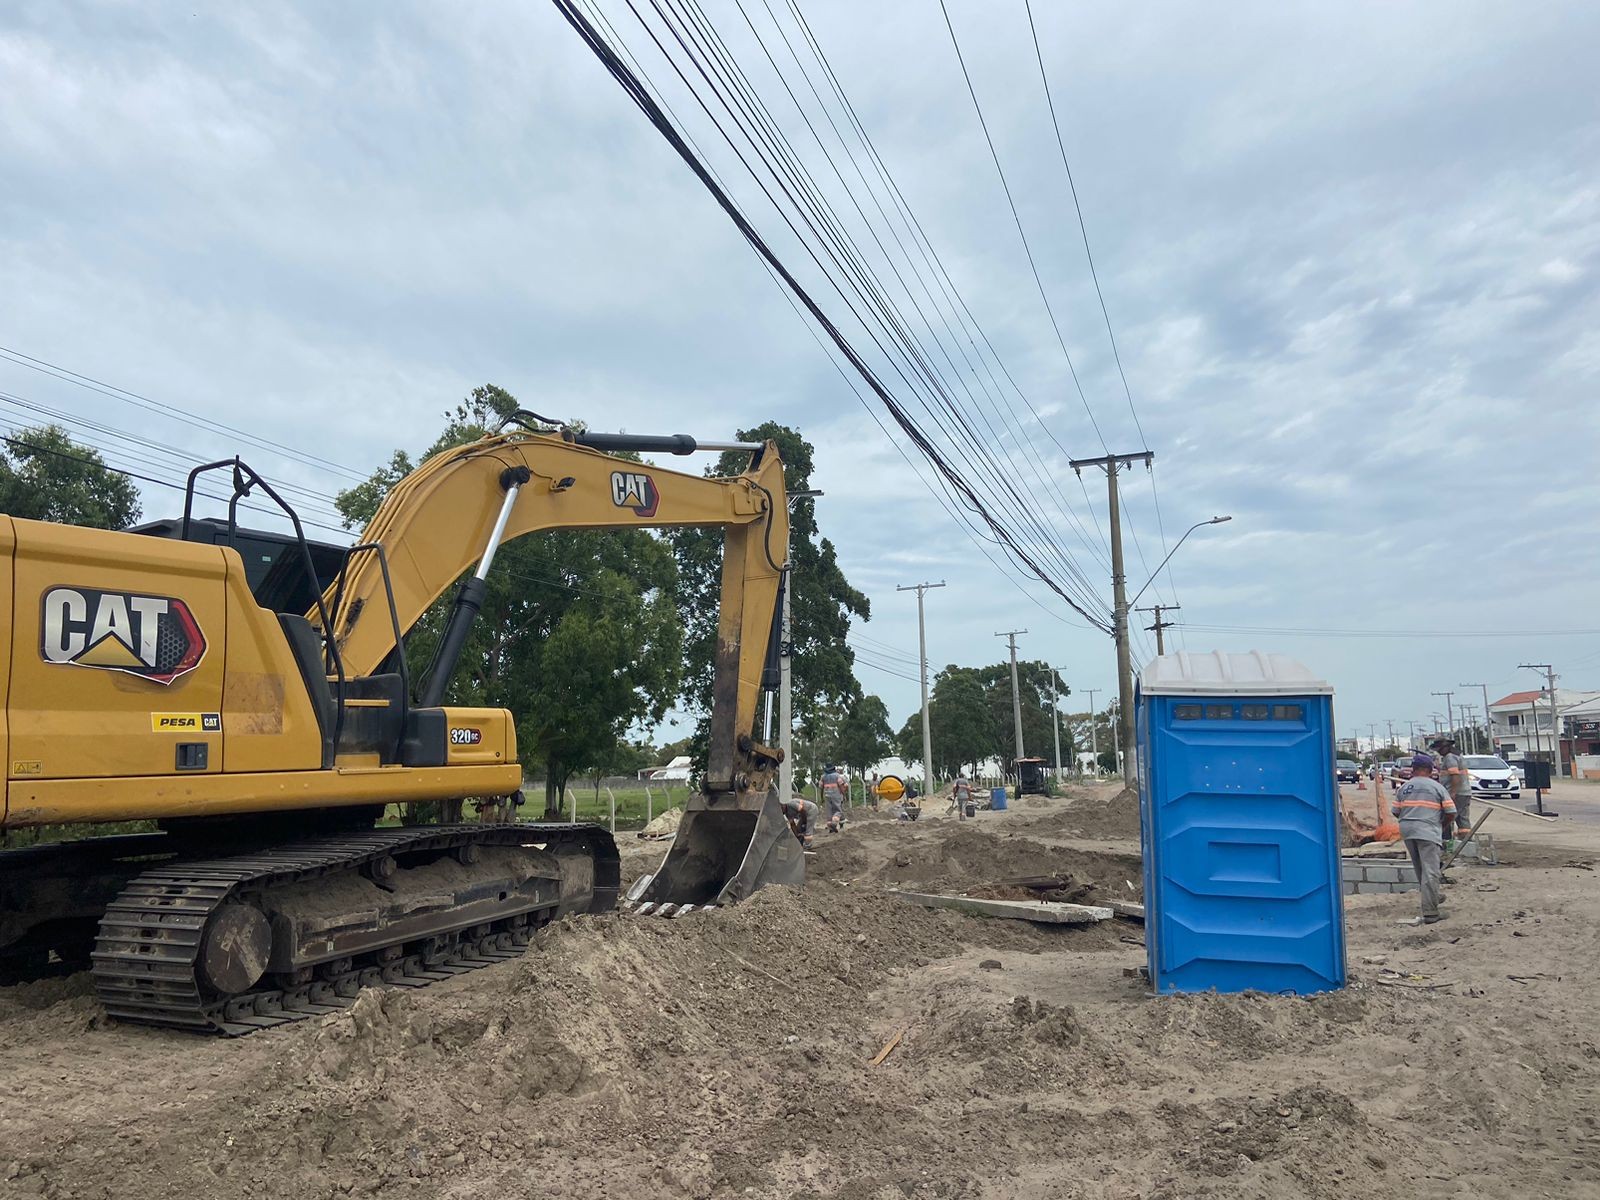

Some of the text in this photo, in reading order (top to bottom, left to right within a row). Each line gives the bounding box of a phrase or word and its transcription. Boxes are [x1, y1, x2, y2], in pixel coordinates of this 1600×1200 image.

[611, 472, 647, 507] CAT
[45, 588, 169, 667] CAT
[160, 718, 196, 727] PESA
[203, 717, 218, 727] CAT
